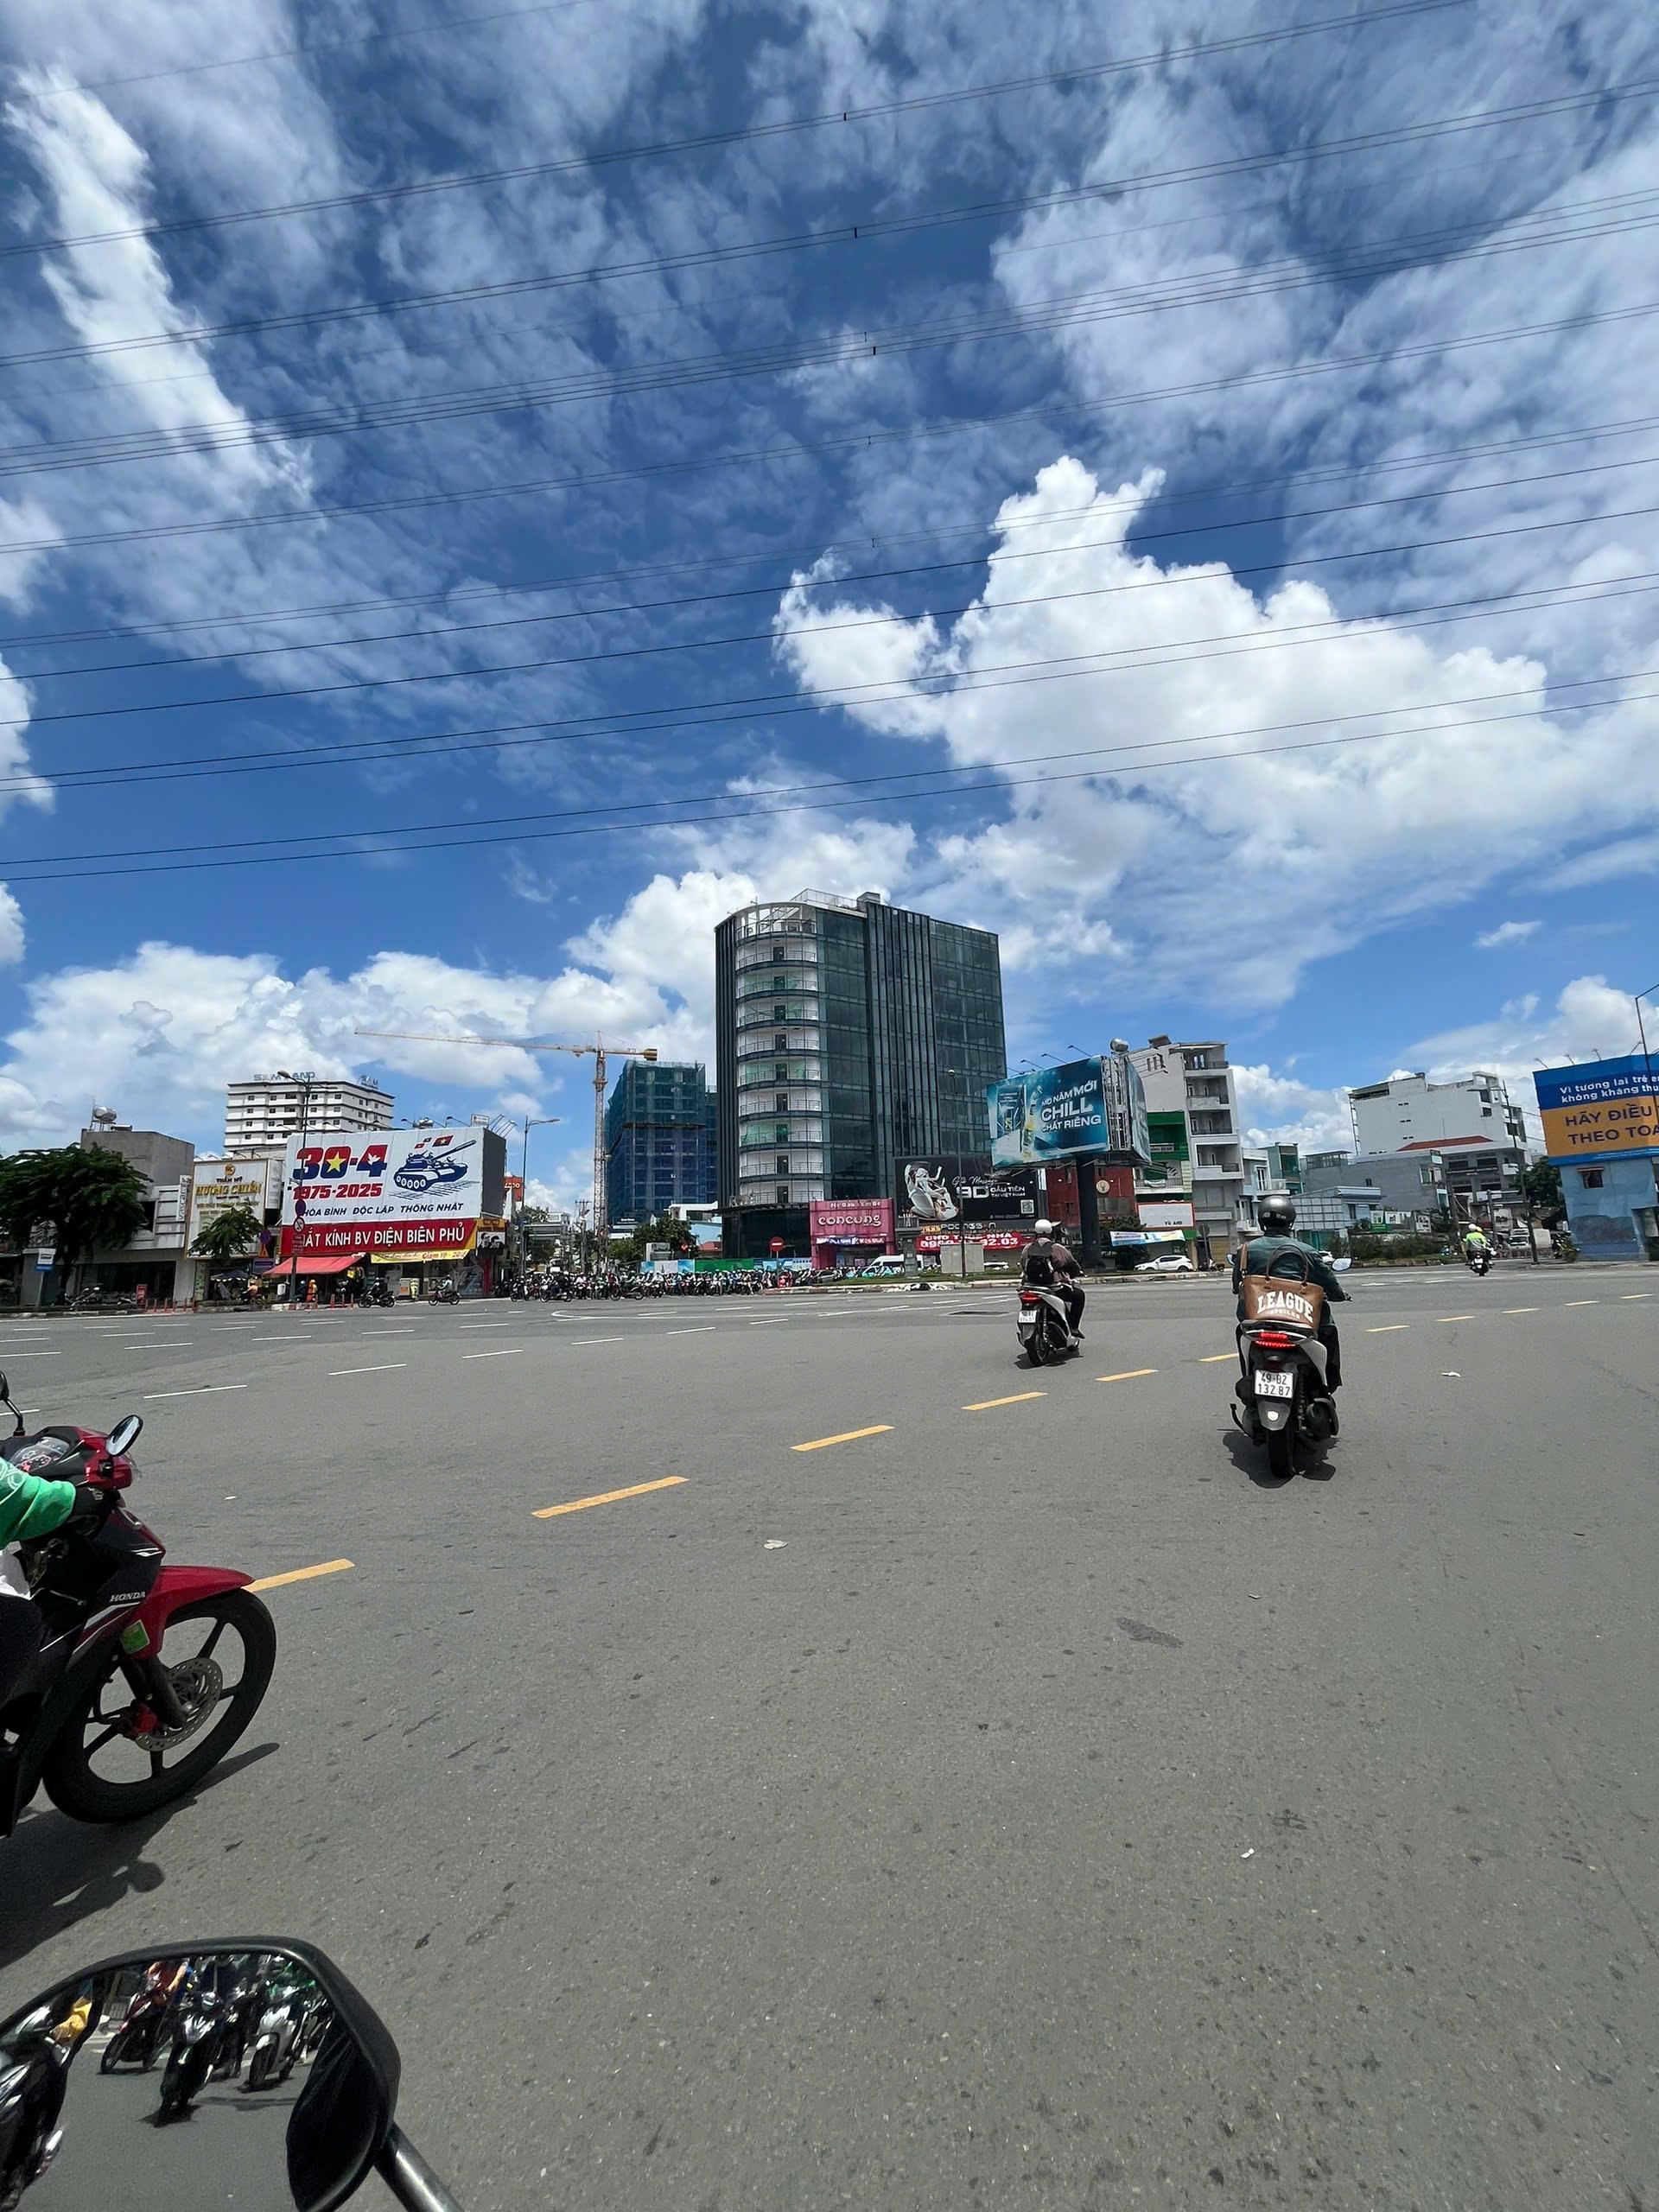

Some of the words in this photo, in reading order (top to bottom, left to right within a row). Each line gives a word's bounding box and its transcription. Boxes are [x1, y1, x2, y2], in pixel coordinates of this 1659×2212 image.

[1074, 1079, 1097, 1096] MỚI
[1561, 1092, 1598, 1103] không
[1602, 1085, 1639, 1097] kháng
[1575, 1081, 1610, 1092] tương
[1041, 1096, 1093, 1122] CHILL
[1565, 1110, 1601, 1127] HÃY
[1608, 1103, 1652, 1121] ĐIỀU
[1065, 1115, 1102, 1128] RIÊNG
[1568, 1129, 1619, 1145] THEO
[292, 1144, 388, 1180] 30-4
[293, 1183, 384, 1200] 1975-2025
[324, 1206, 347, 1217] BÌNH
[352, 1205, 374, 1216] ĐỘC
[400, 1202, 435, 1214] THỐNG
[435, 1201, 465, 1212] NHẤT
[325, 1229, 352, 1247] KÍNH
[354, 1231, 372, 1245] BV
[374, 1227, 403, 1247] ĐIỆN
[407, 1226, 435, 1243] BIÊN
[439, 1222, 465, 1242] PHỦ
[1256, 1290, 1313, 1324] LEAGUE
[110, 1592, 146, 1603] HONDA
